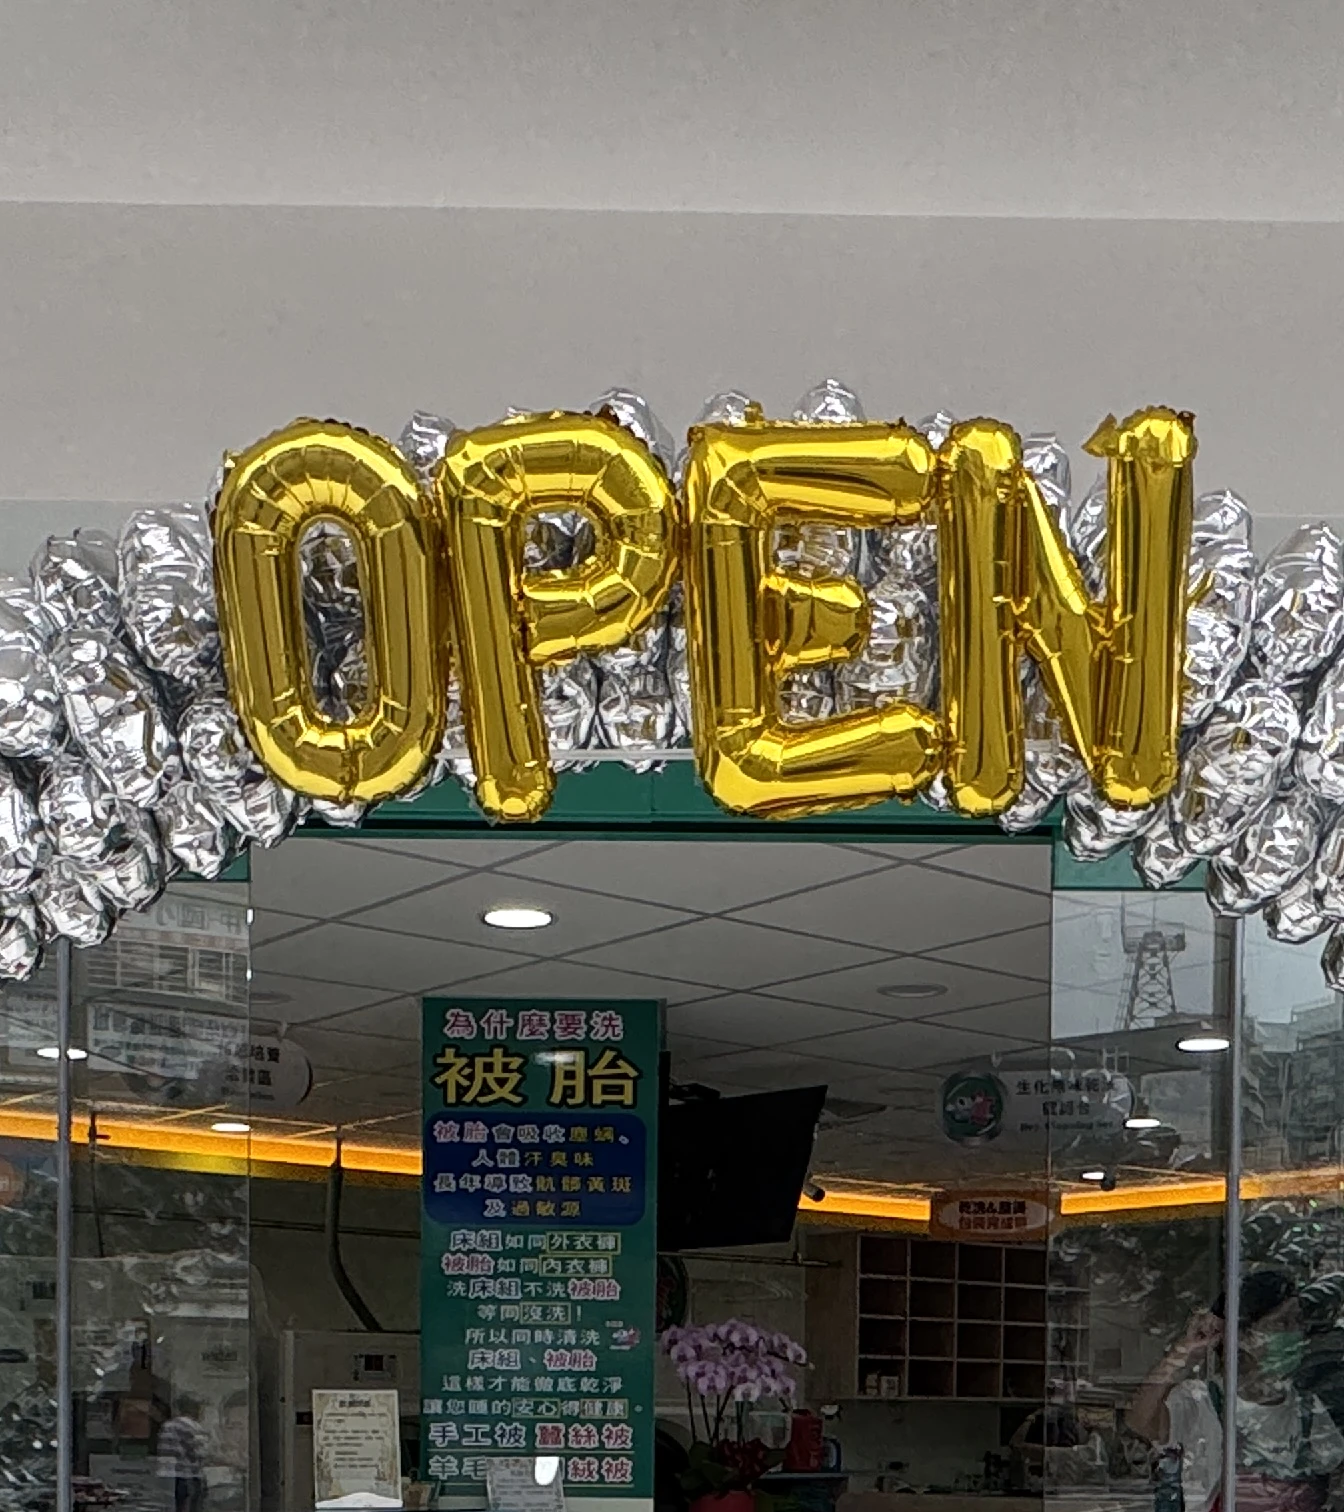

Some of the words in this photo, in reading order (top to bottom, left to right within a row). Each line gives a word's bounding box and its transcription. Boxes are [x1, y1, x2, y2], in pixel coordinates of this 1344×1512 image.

[212, 406, 1197, 822] OPEN
[445, 1009, 623, 1041] 為什麼要洗
[434, 1047, 641, 1107] 被胎
[450, 1229, 617, 1251] 床組如同外衣褲
[442, 1253, 609, 1275] 被胎如同內衣褲
[447, 1278, 621, 1300] 洗床組不洗被胎
[465, 1328, 600, 1345] 所以同時清洗
[429, 1422, 526, 1448] 手工被
[535, 1423, 634, 1449] 蠶絲被
[428, 1455, 487, 1481] 羊毛
[560, 1456, 634, 1483] 絨被
